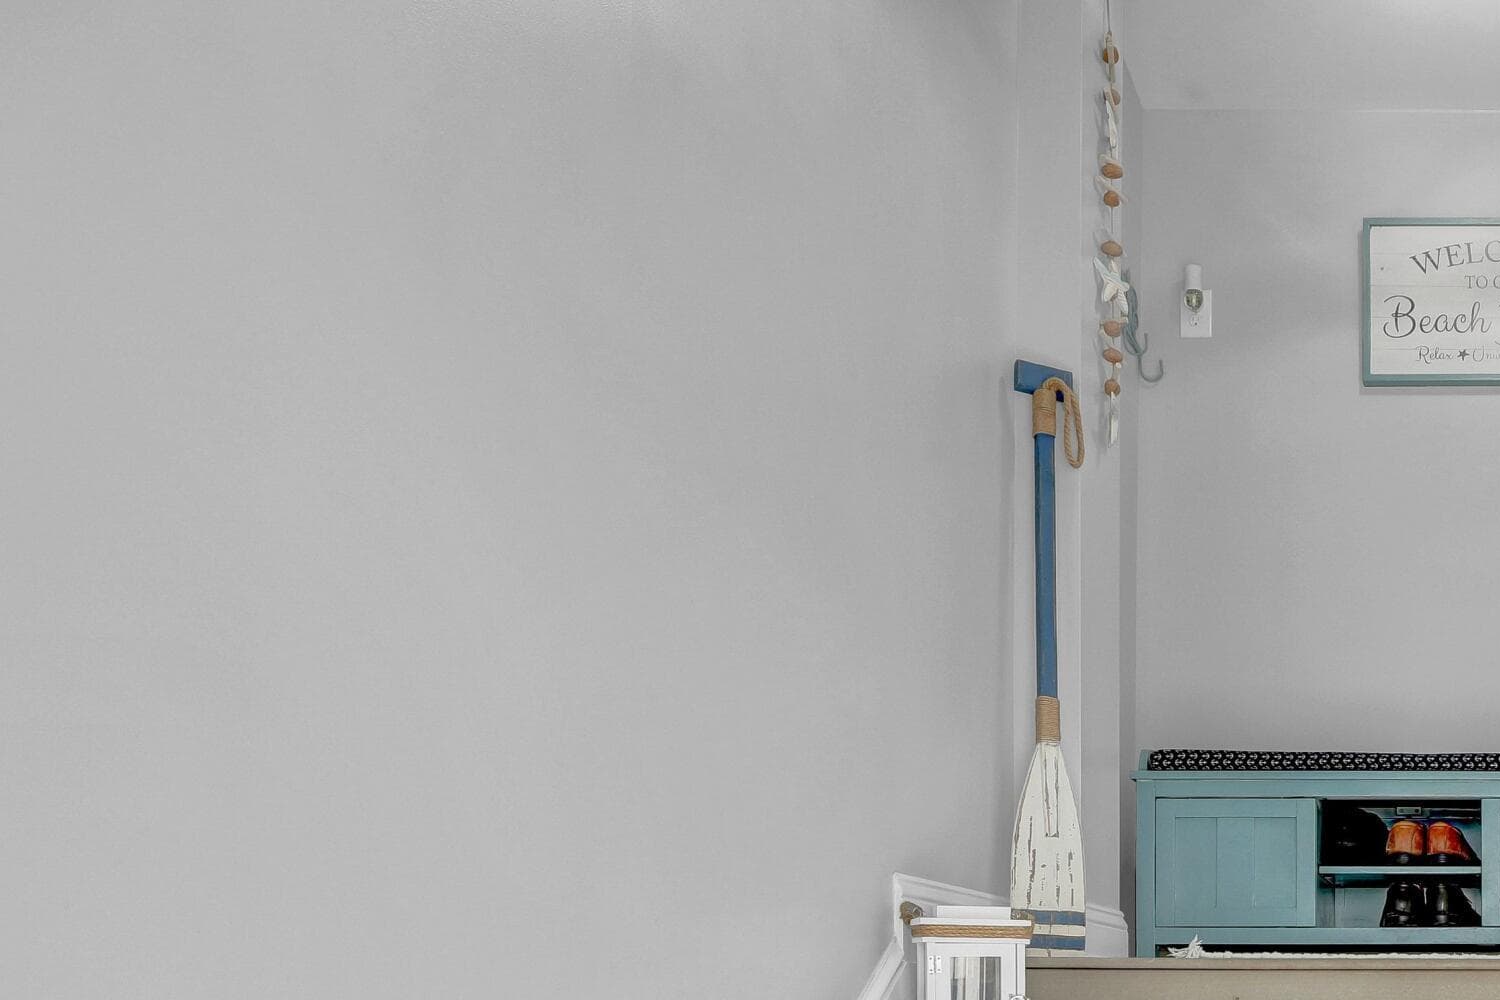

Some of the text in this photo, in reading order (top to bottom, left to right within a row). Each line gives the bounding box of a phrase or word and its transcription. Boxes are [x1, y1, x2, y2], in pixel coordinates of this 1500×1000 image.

[1464, 275, 1488, 289] TO
[1383, 295, 1493, 338] Beach
[1415, 346, 1454, 364] Relax
